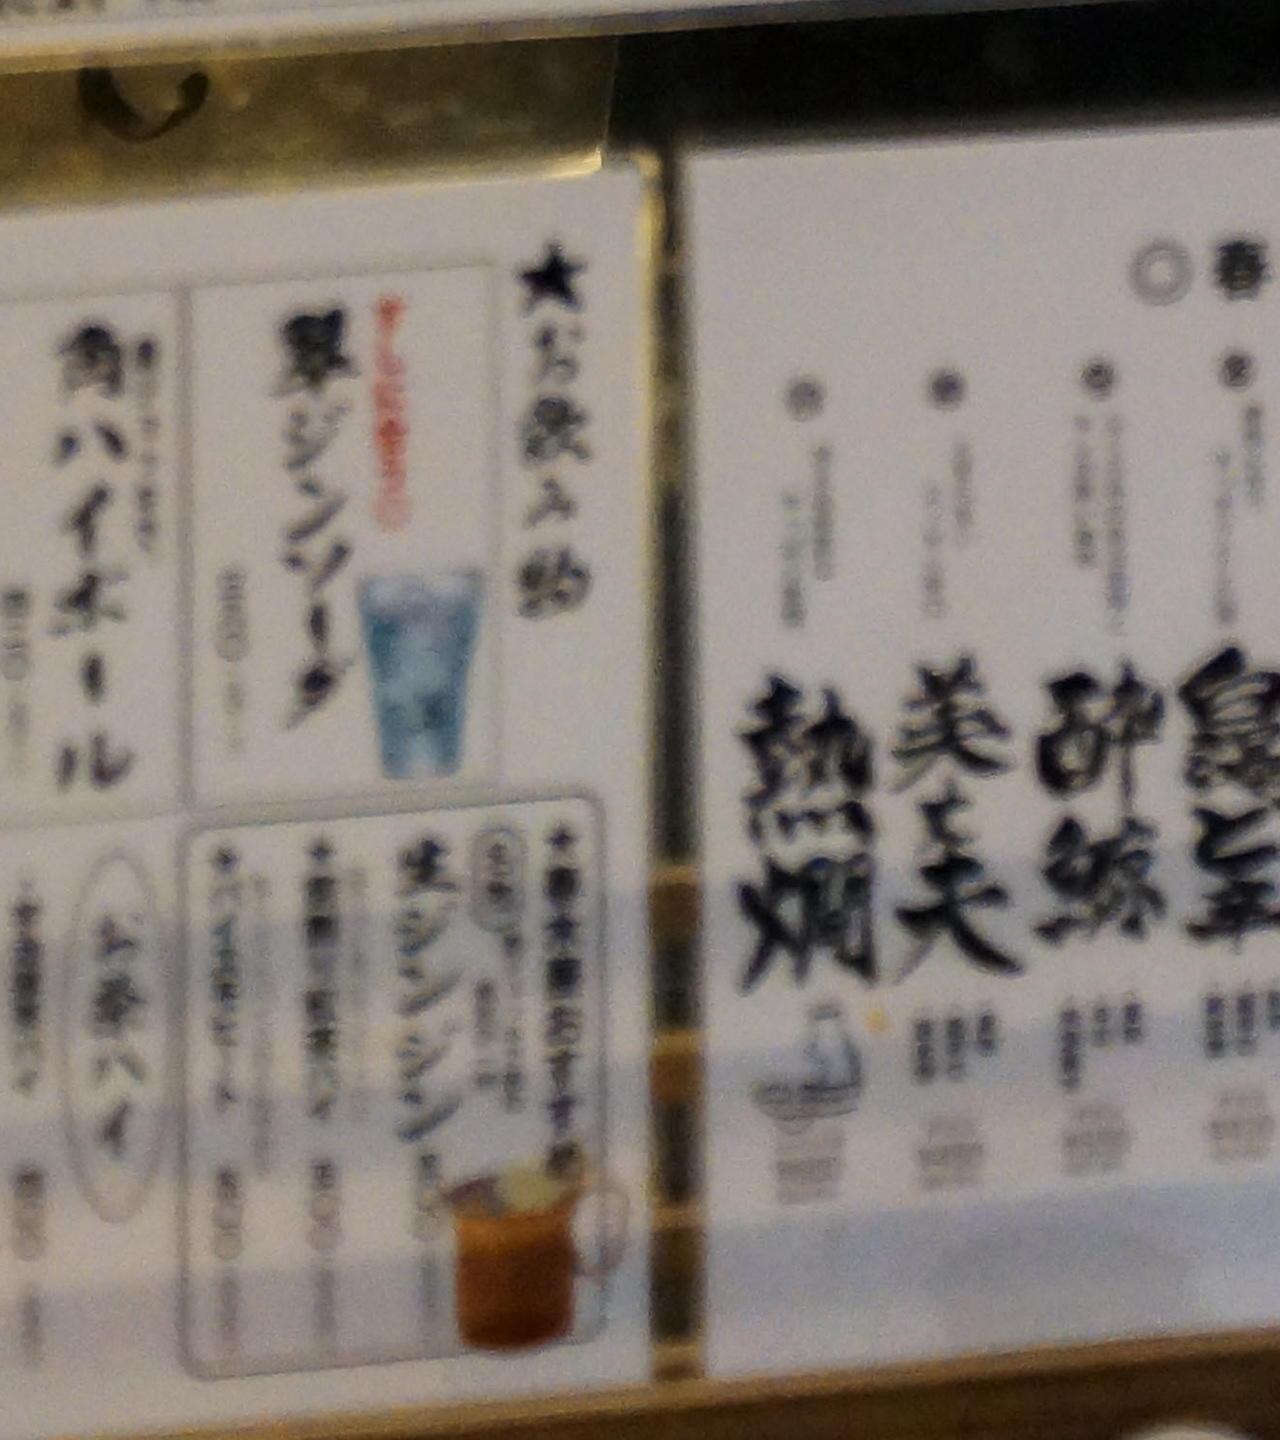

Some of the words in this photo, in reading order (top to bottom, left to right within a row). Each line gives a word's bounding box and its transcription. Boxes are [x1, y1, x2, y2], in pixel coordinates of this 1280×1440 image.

[50, 318, 137, 794] 角ハイボール
[734, 668, 880, 996] 熱燗
[1030, 656, 1166, 950] 酔鯨
